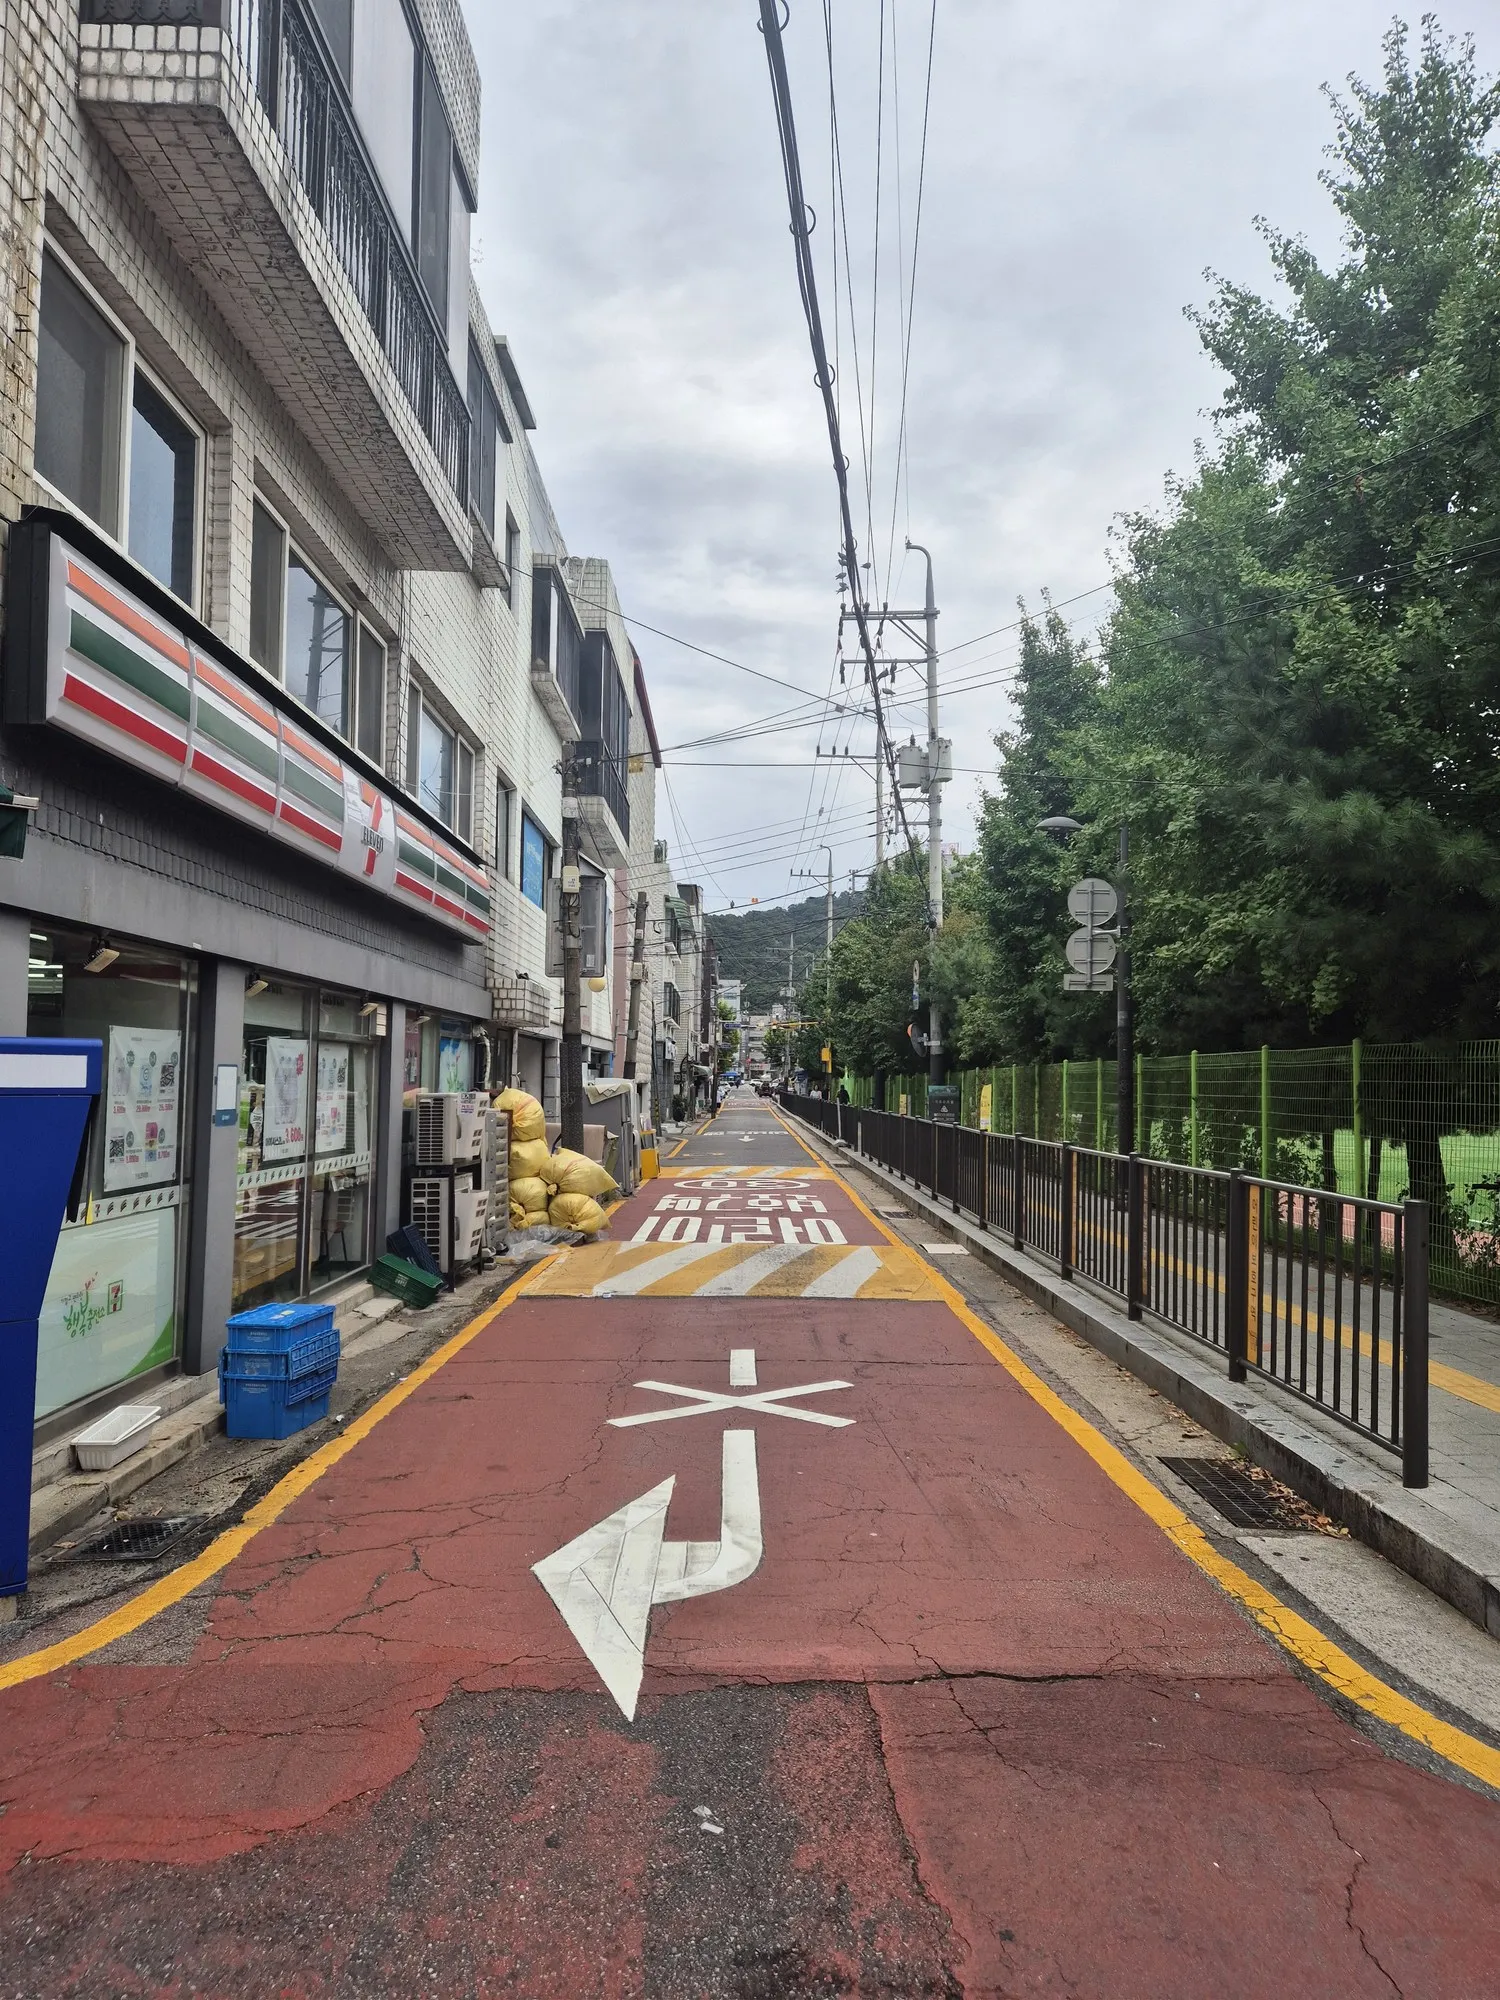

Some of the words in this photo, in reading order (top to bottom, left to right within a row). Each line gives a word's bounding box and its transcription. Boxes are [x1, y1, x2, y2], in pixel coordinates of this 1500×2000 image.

[701, 1180, 789, 1189] 30
[653, 1193, 828, 1213] 보호구역
[630, 1216, 849, 1245] 어린이
